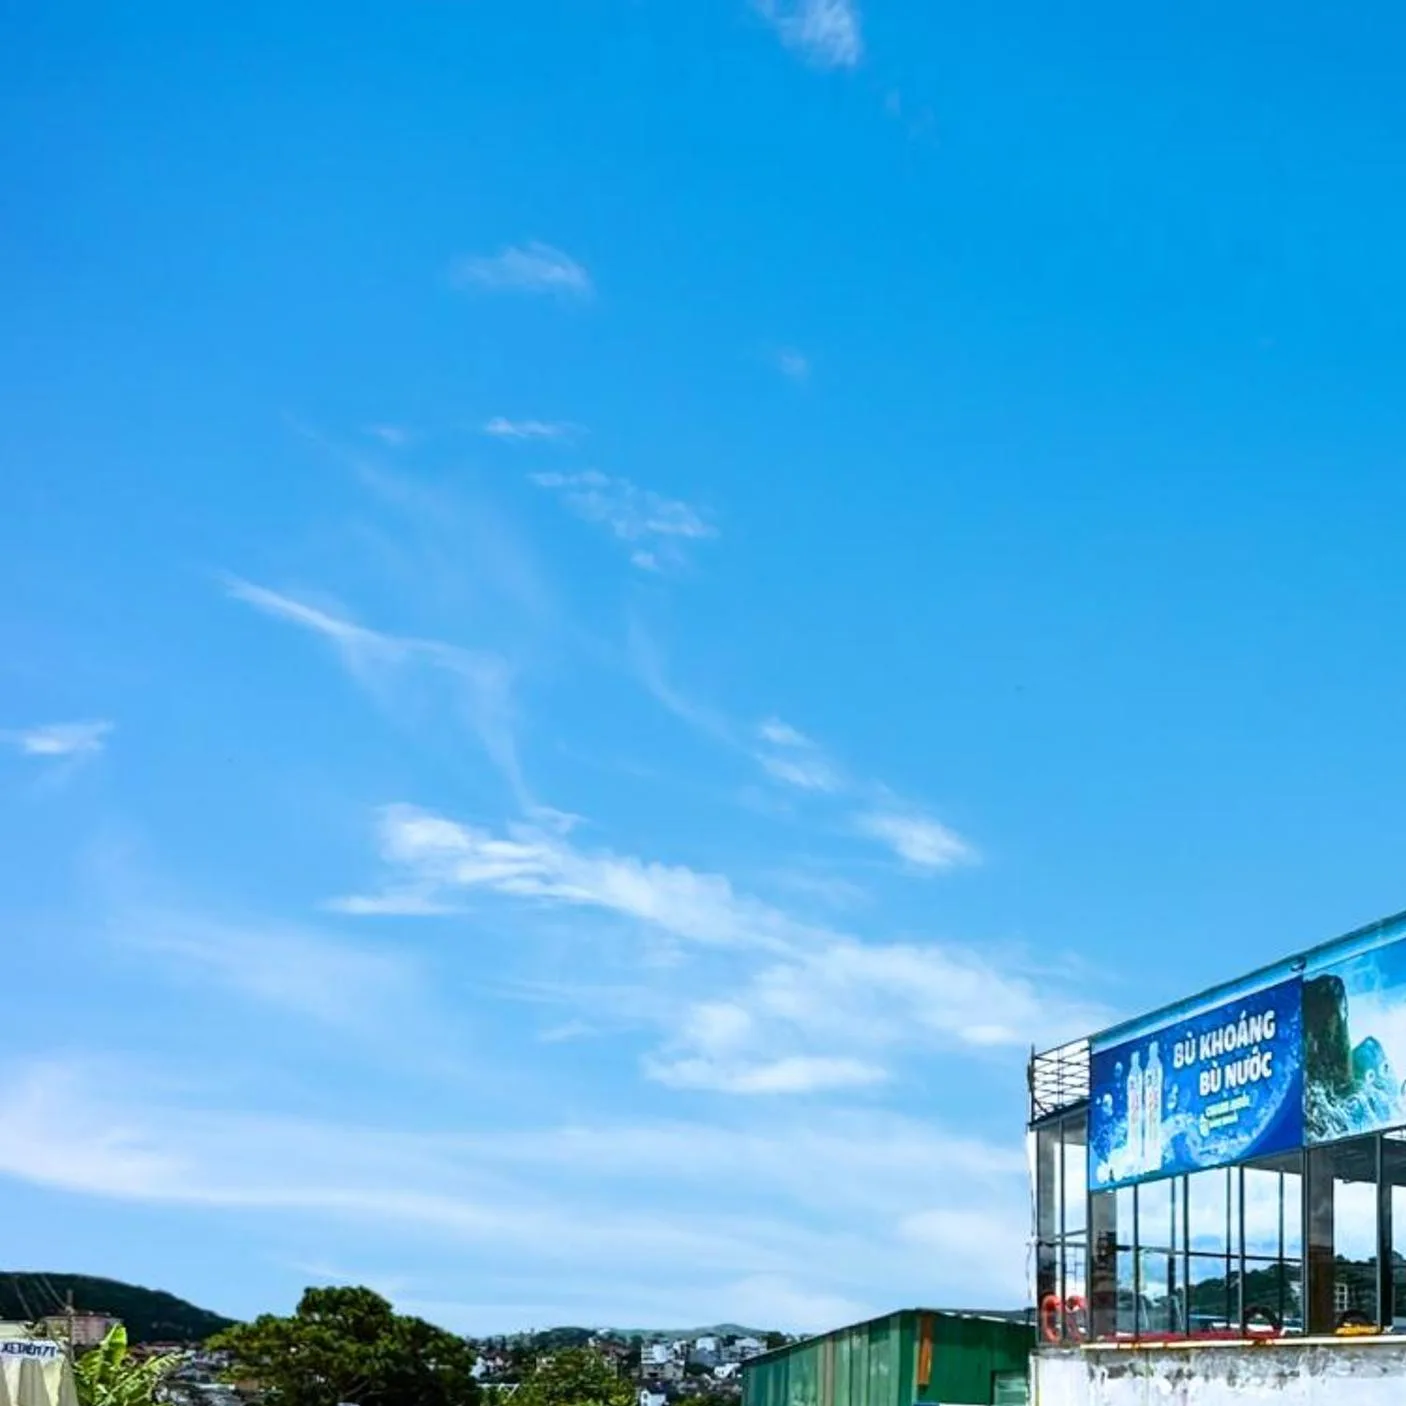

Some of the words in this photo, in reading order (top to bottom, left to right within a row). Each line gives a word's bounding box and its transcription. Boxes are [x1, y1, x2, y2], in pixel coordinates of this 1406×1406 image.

[1172, 1031, 1196, 1069] BÙ
[1199, 1010, 1276, 1061] KHOÁNG
[1199, 1061, 1222, 1096] BÙ
[1225, 1047, 1273, 1089] NƯỚC
